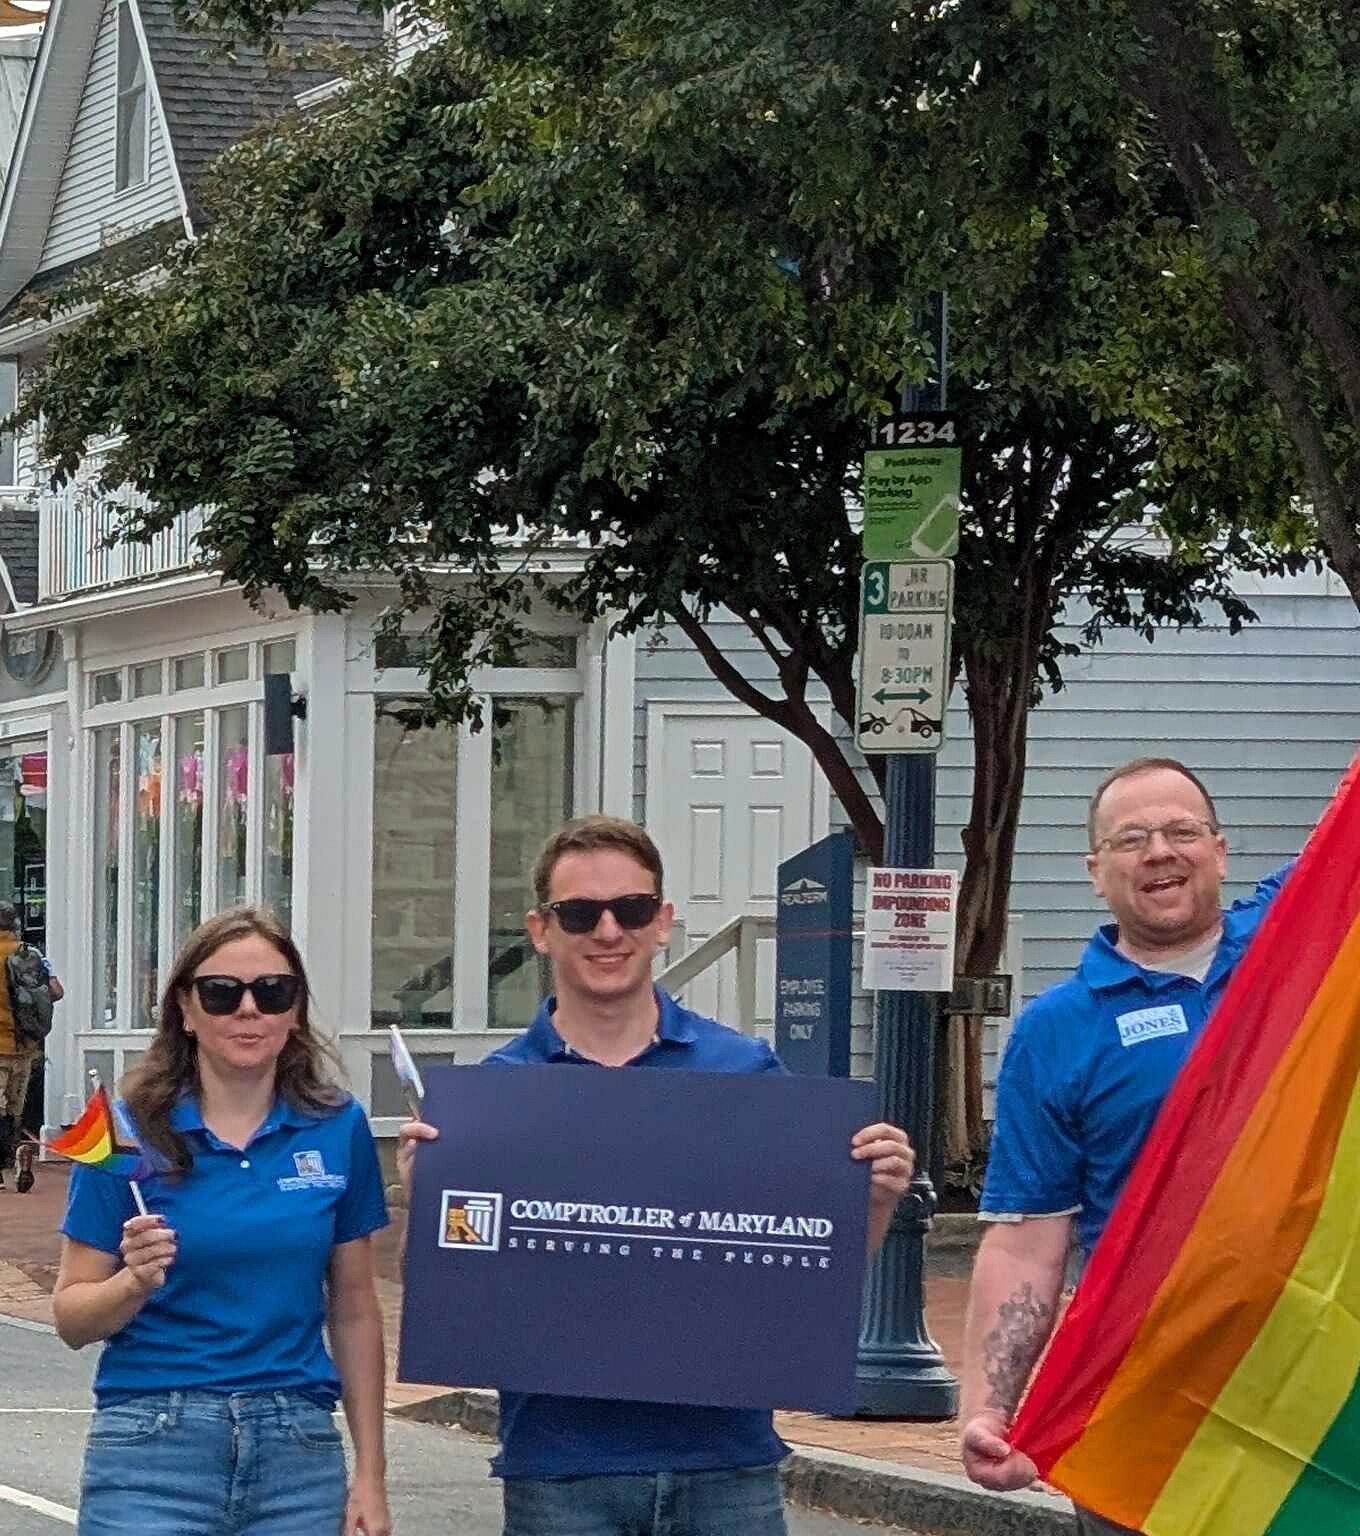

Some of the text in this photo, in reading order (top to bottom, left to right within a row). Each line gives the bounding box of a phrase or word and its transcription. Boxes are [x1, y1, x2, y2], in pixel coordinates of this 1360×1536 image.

[868, 476, 889, 487] Pay
[908, 474, 933, 487] App
[867, 571, 885, 606] 3
[891, 590, 946, 609] PARKING
[873, 873, 952, 889] NO PARKING
[894, 912, 927, 928] ZONE
[783, 1001, 822, 1017] PARKING
[789, 1023, 813, 1040] ONLY
[1122, 1017, 1182, 1039] JONES
[510, 1199, 675, 1229] COMPTROLLER
[698, 1210, 833, 1239] MARYLAND
[508, 1237, 831, 1269] SERVING THE PEOPLE
